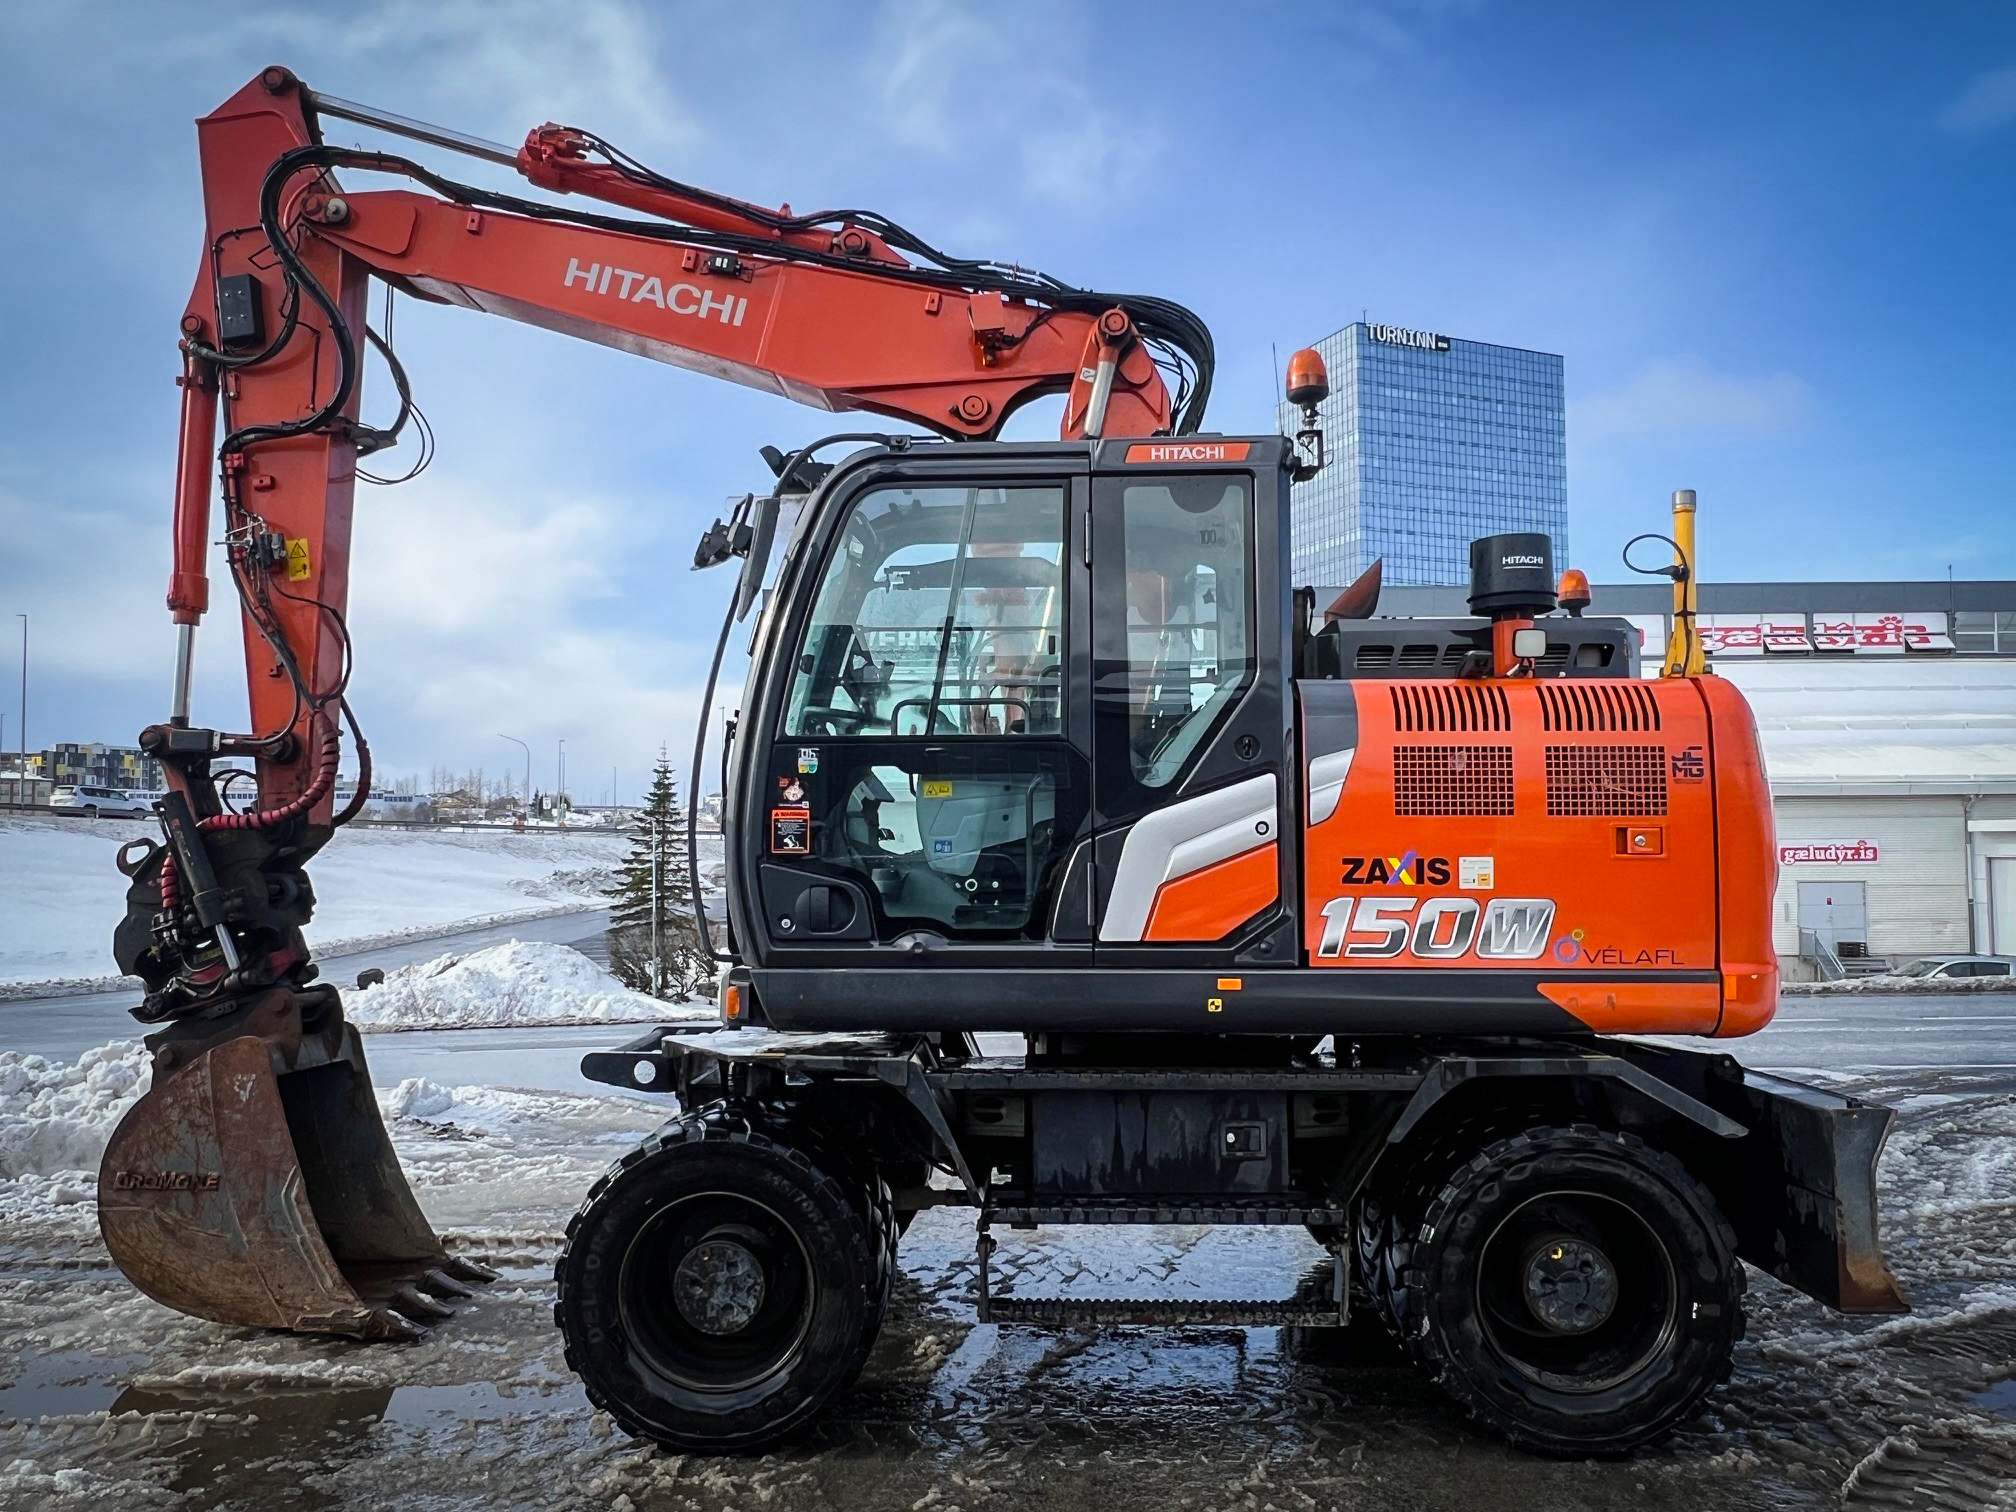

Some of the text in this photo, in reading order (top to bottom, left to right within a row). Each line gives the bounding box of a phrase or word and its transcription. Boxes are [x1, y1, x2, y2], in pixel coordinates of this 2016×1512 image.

[563, 257, 748, 327] HITACHI
[1366, 323, 1436, 350] TURNINN
[1150, 446, 1225, 460] HITACHI
[1502, 556, 1544, 565] HITACHI
[1783, 844, 1875, 865] gæludýr.is
[1341, 850, 1451, 886] ZAXIS
[1317, 897, 1557, 960] 150W
[1582, 944, 1685, 965] VÉLAFL
